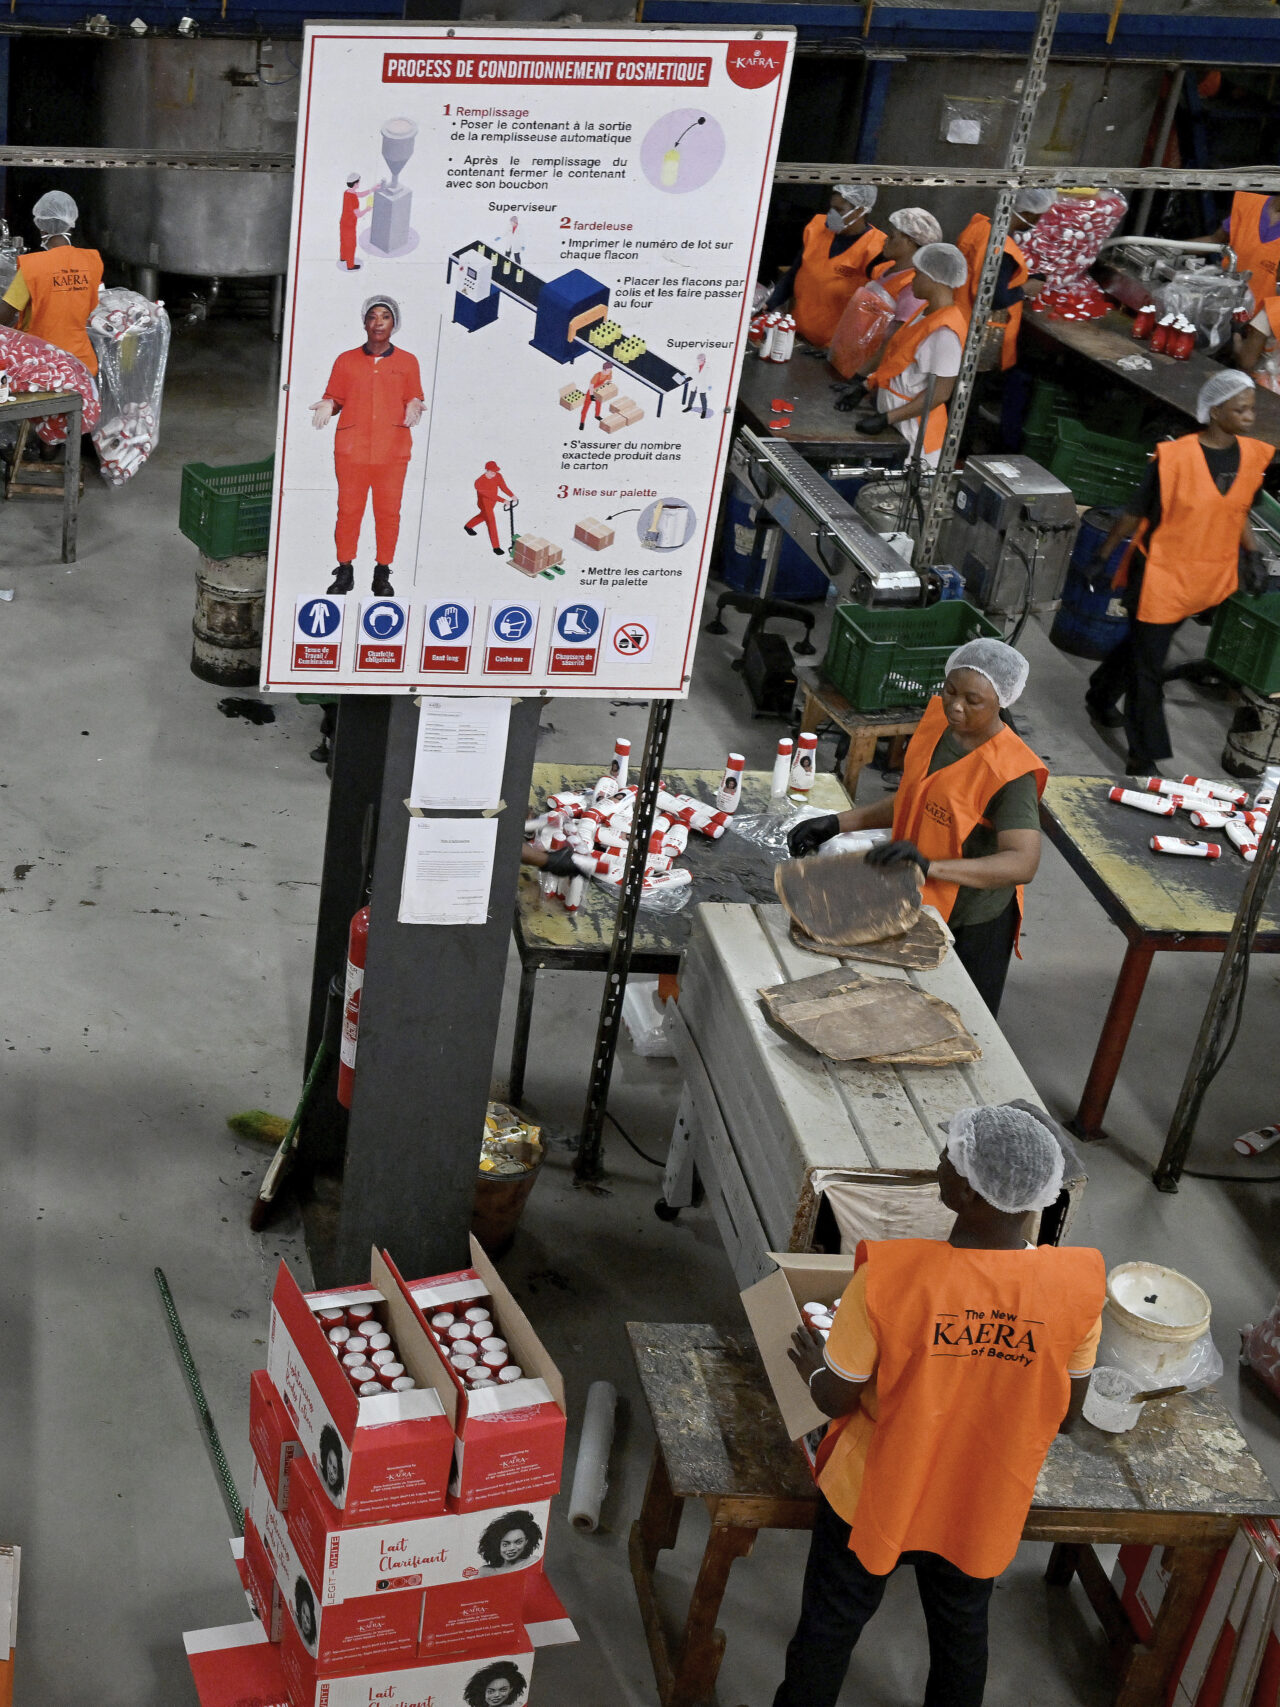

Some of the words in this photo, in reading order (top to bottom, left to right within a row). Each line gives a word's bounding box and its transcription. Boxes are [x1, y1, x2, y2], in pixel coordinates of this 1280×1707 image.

[387, 59, 452, 78] PROCESS
[455, 60, 474, 78] DE
[478, 60, 614, 80] CONDITIONNEMENT
[616, 62, 707, 81] COSMETIQUE
[443, 104, 451, 116] 1
[457, 106, 529, 119] Remplissage
[460, 120, 493, 130] Poser
[498, 120, 507, 130] le
[512, 121, 570, 131] contenant
[573, 121, 580, 131] à
[584, 122, 594, 131] la
[598, 122, 632, 132] sortie
[450, 132, 465, 141] de
[468, 132, 478, 141] la
[481, 132, 557, 144] remplisseuse
[560, 134, 632, 145] automatique
[464, 154, 498, 167] Après
[510, 156, 520, 166] le
[532, 156, 601, 168] remplissage
[613, 158, 628, 167] du
[447, 168, 504, 177] contenant
[509, 168, 548, 178] fermer
[553, 168, 563, 178] le
[568, 169, 626, 178] contenant
[446, 181, 472, 189] avec
[476, 181, 496, 189] son
[488, 202, 558, 214] Superviseur
[560, 216, 571, 230] 2
[574, 220, 633, 231] fardeleuse
[568, 238, 620, 249] Imprimer
[622, 238, 632, 248] le
[636, 239, 678, 249] numéro
[681, 240, 694, 249] de
[698, 240, 712, 249] lot
[715, 241, 734, 250] sur
[560, 250, 601, 262] chaque
[604, 250, 639, 260] flacon
[53, 274, 88, 287] KAERA
[624, 276, 660, 286] Placer
[662, 276, 679, 286] les
[682, 277, 722, 287] flacons
[725, 279, 745, 289] par
[616, 288, 641, 298] colis
[644, 289, 656, 298] et
[658, 288, 674, 298] les
[676, 288, 702, 298] faire
[704, 290, 744, 300] passer
[614, 300, 628, 308] au
[630, 299, 653, 308] four
[666, 339, 734, 350] Superviseur
[570, 440, 622, 450] S'assurer
[624, 440, 638, 450] du
[640, 441, 682, 450] nombre
[614, 452, 653, 462] produit
[656, 452, 682, 461] dans
[561, 461, 571, 470] le
[573, 462, 608, 470] carton
[557, 484, 569, 499] 3
[572, 488, 597, 496] Mise
[620, 488, 657, 498] palette
[588, 567, 621, 576] Mettre
[624, 567, 640, 576] les
[642, 568, 682, 576] cartons
[580, 578, 598, 586] sur
[600, 577, 609, 586] la
[612, 578, 648, 588] palette
[965, 1310, 985, 1320] The
[990, 1310, 1018, 1322] New
[933, 1322, 1037, 1354] KAERA
[971, 1347, 986, 1356] of
[987, 1348, 1034, 1368] Beauty
[330, 1536, 340, 1568] WHITE
[380, 1538, 408, 1555] Lait
[379, 1548, 449, 1572] Clarifiant
[328, 1578, 336, 1604] LEGIT
[369, 1685, 397, 1701] Lait
